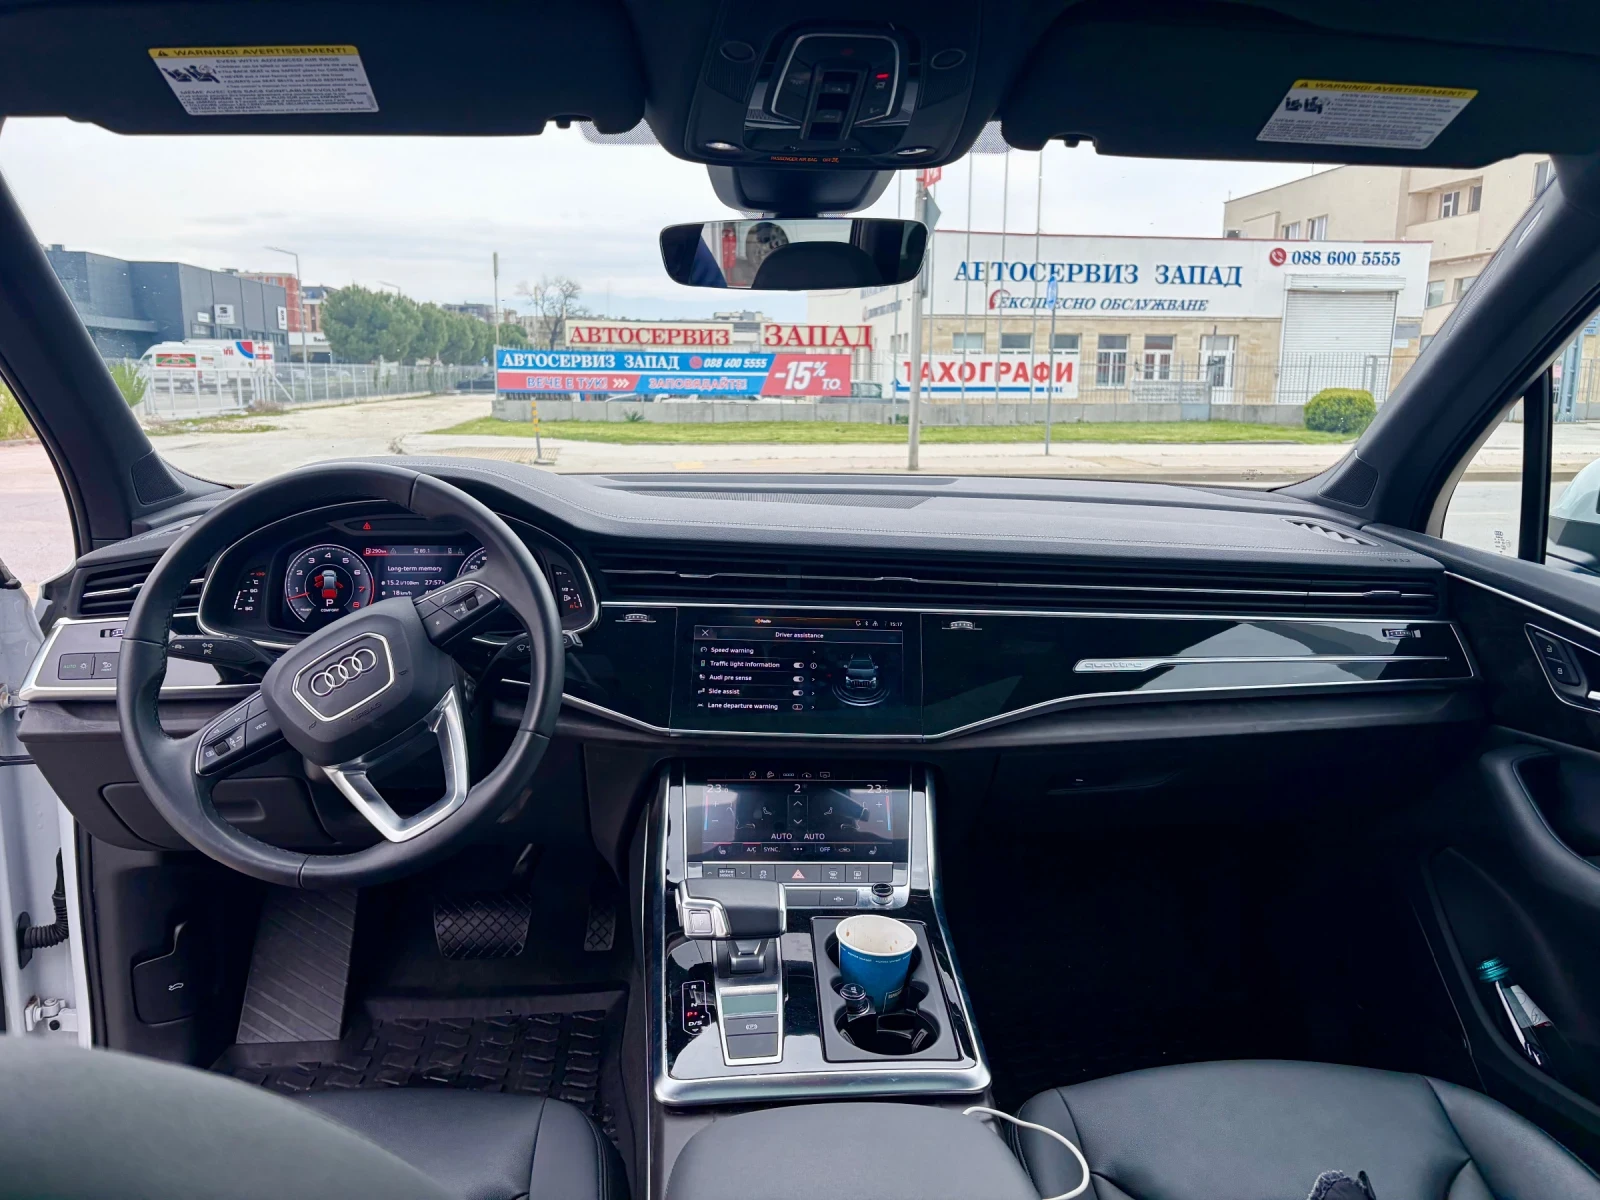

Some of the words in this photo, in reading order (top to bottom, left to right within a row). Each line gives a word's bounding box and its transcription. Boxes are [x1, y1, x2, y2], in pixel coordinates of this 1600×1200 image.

[1315, 82, 1371, 91] WARNING!
[1374, 86, 1468, 96] AVERTISSEMENT!
[1292, 250, 1321, 265] 088
[1327, 251, 1356, 265] 600
[1361, 251, 1400, 266] 5555
[954, 261, 1138, 284] АВТОСЕРВИЗ
[1155, 264, 1243, 288] ЗАПАД
[1100, 298, 1209, 311] ОБСЛУЖВАНЕ
[570, 326, 730, 346] АВТОСЕРВИЗ
[764, 324, 872, 351] ЗАПАД
[502, 353, 615, 368] АВТОСЕРВИЗ
[624, 355, 680, 370] ЗАПАД
[703, 358, 723, 368] 088
[724, 358, 742, 368] 600
[743, 358, 768, 368] 5555
[774, 361, 828, 390] -15%
[903, 361, 1073, 383] ТАХОГРАФИ
[526, 376, 561, 389] ВЕЧЕ
[565, 377, 574, 389] Е
[576, 377, 608, 389] ТУК!
[649, 377, 747, 391] ЗАПОВЯДАЙТЕ!
[794, 784, 801, 793] 2
